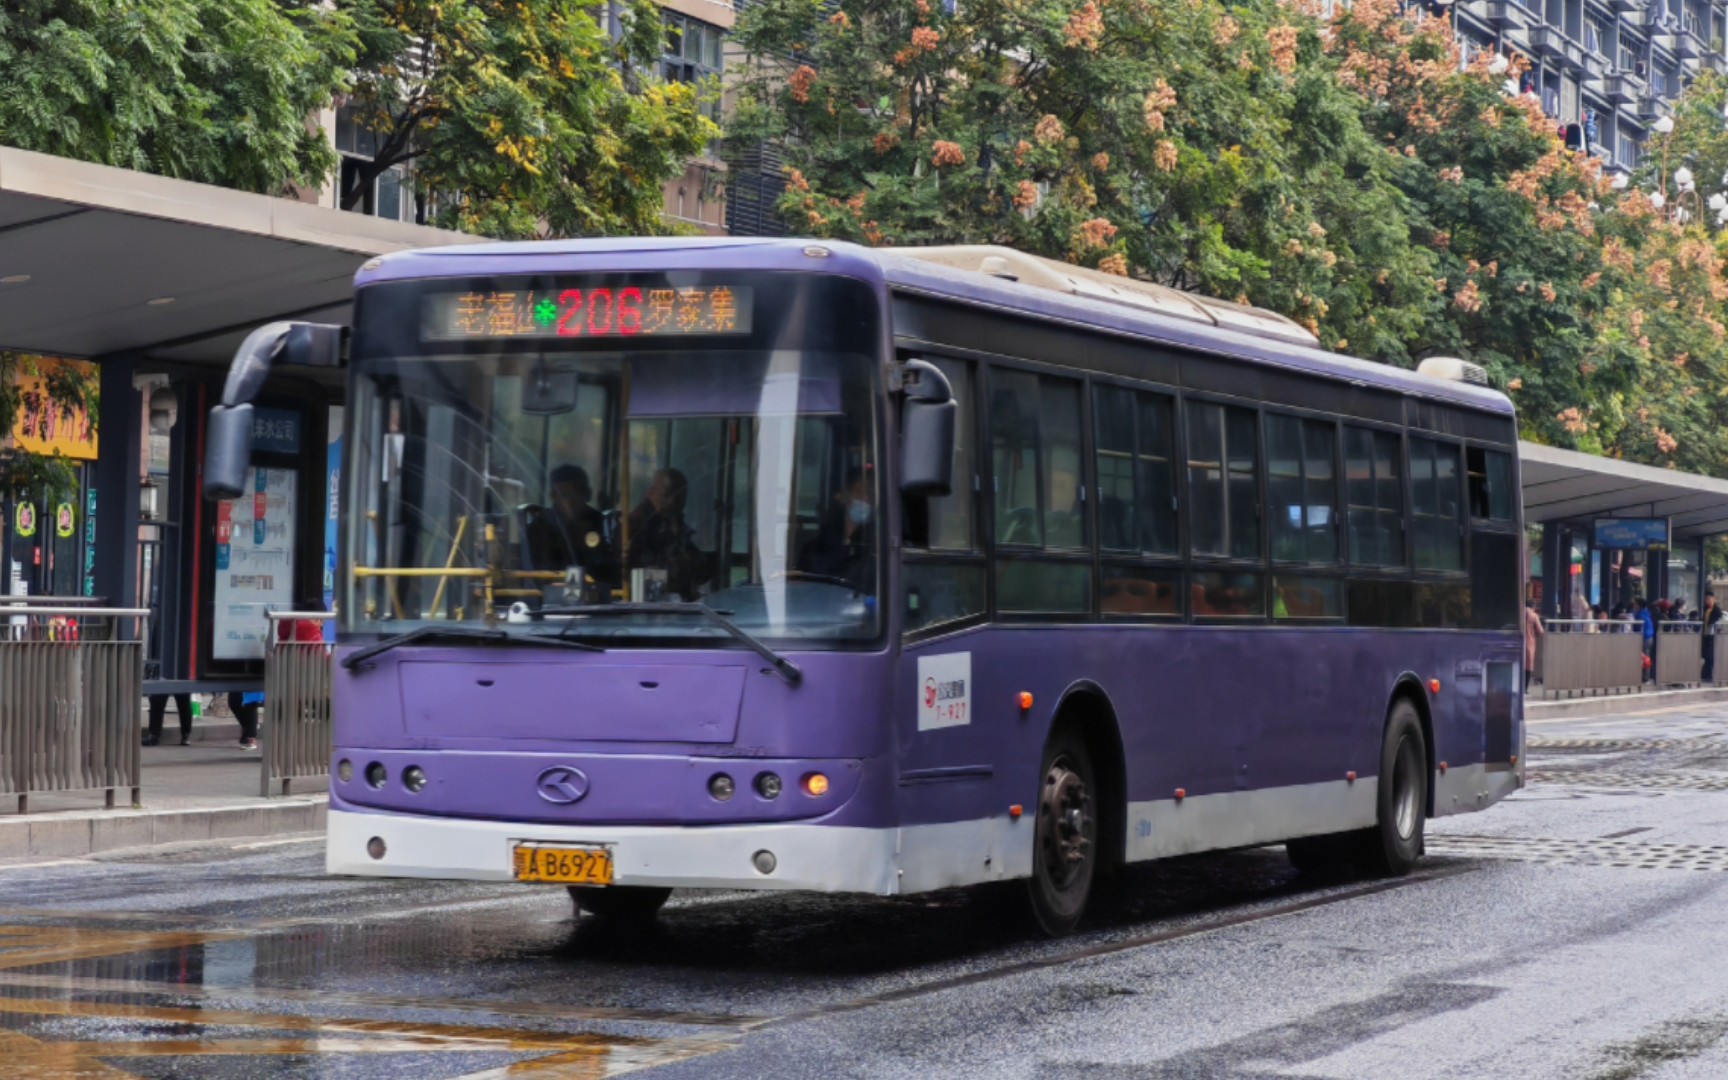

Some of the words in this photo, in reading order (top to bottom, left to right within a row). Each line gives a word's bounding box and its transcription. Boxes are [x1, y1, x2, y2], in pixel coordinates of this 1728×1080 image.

[557, 287, 643, 336] 206
[643, 286, 737, 333] 罗家集
[251, 418, 295, 441] 来水公司
